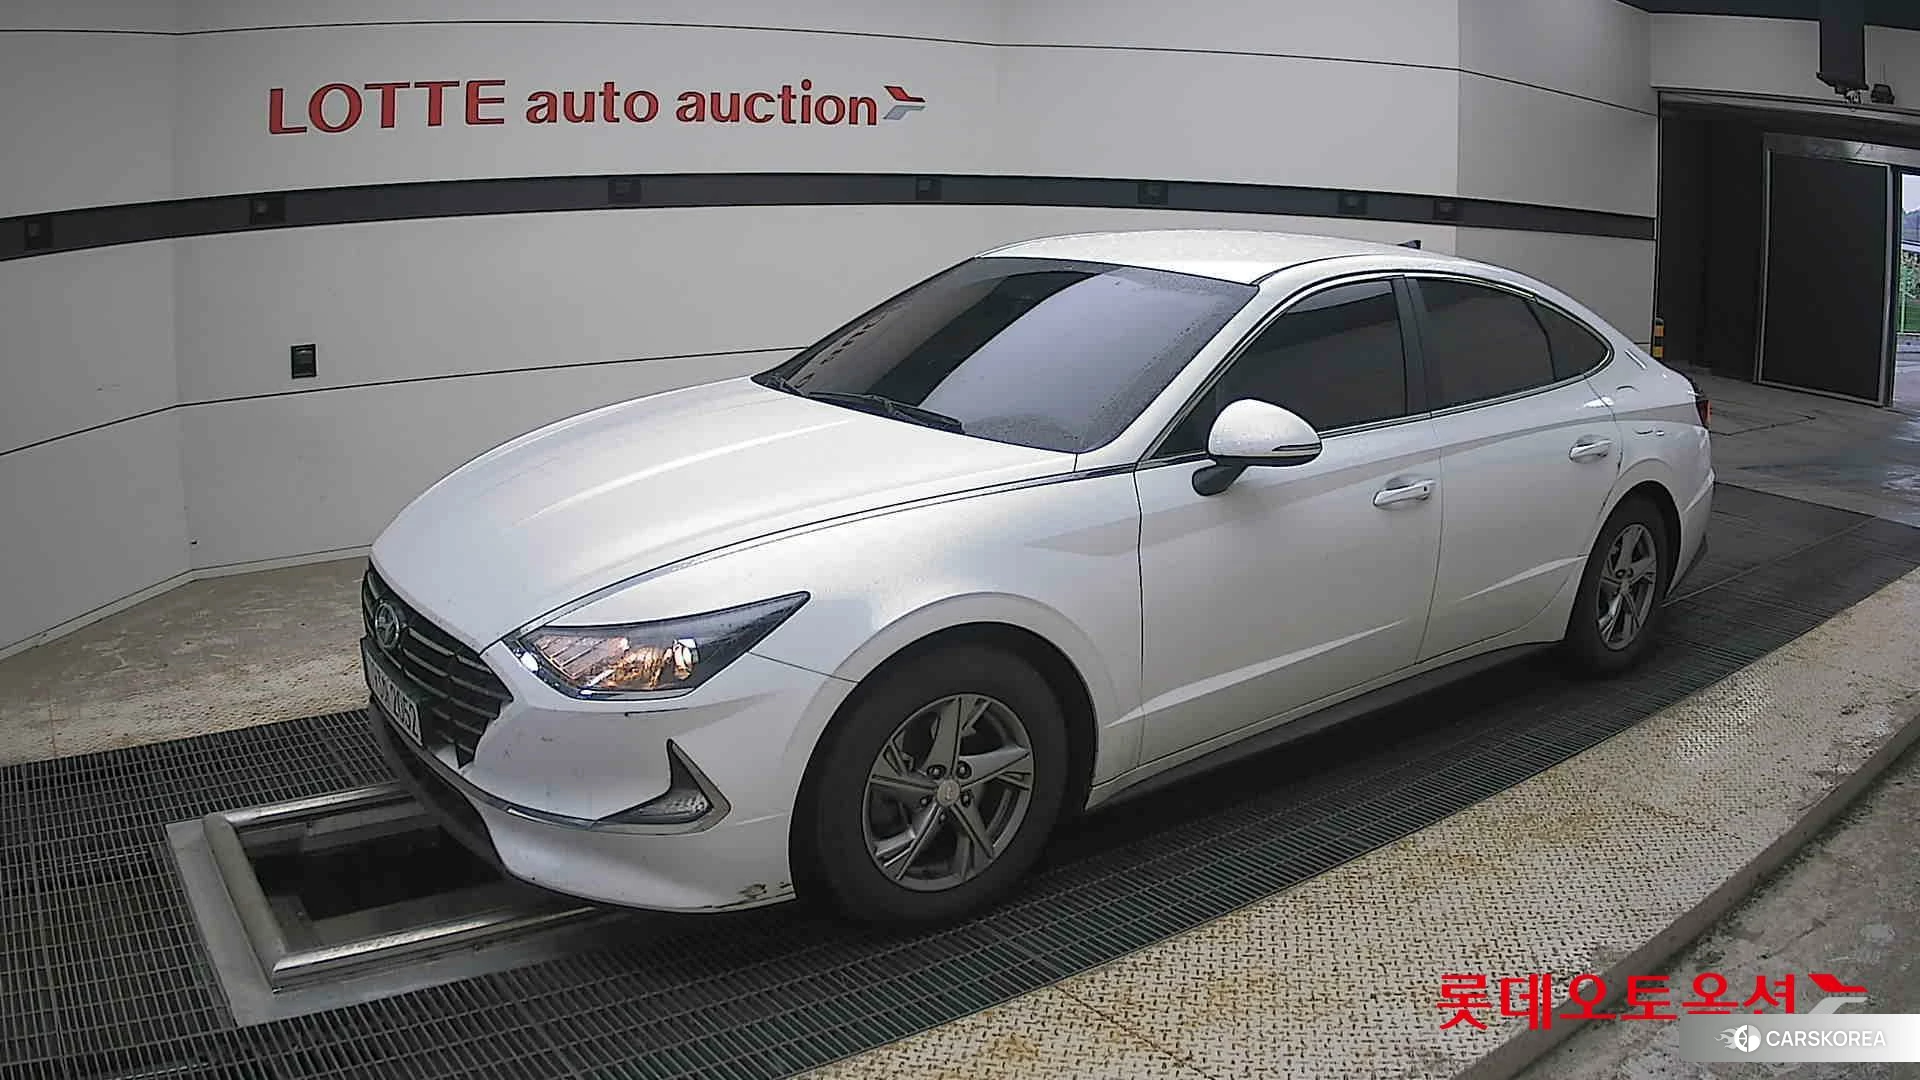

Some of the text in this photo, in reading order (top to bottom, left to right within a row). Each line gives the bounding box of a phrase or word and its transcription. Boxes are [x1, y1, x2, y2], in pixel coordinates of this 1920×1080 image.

[268, 79, 879, 134] LOTTE auto auction
